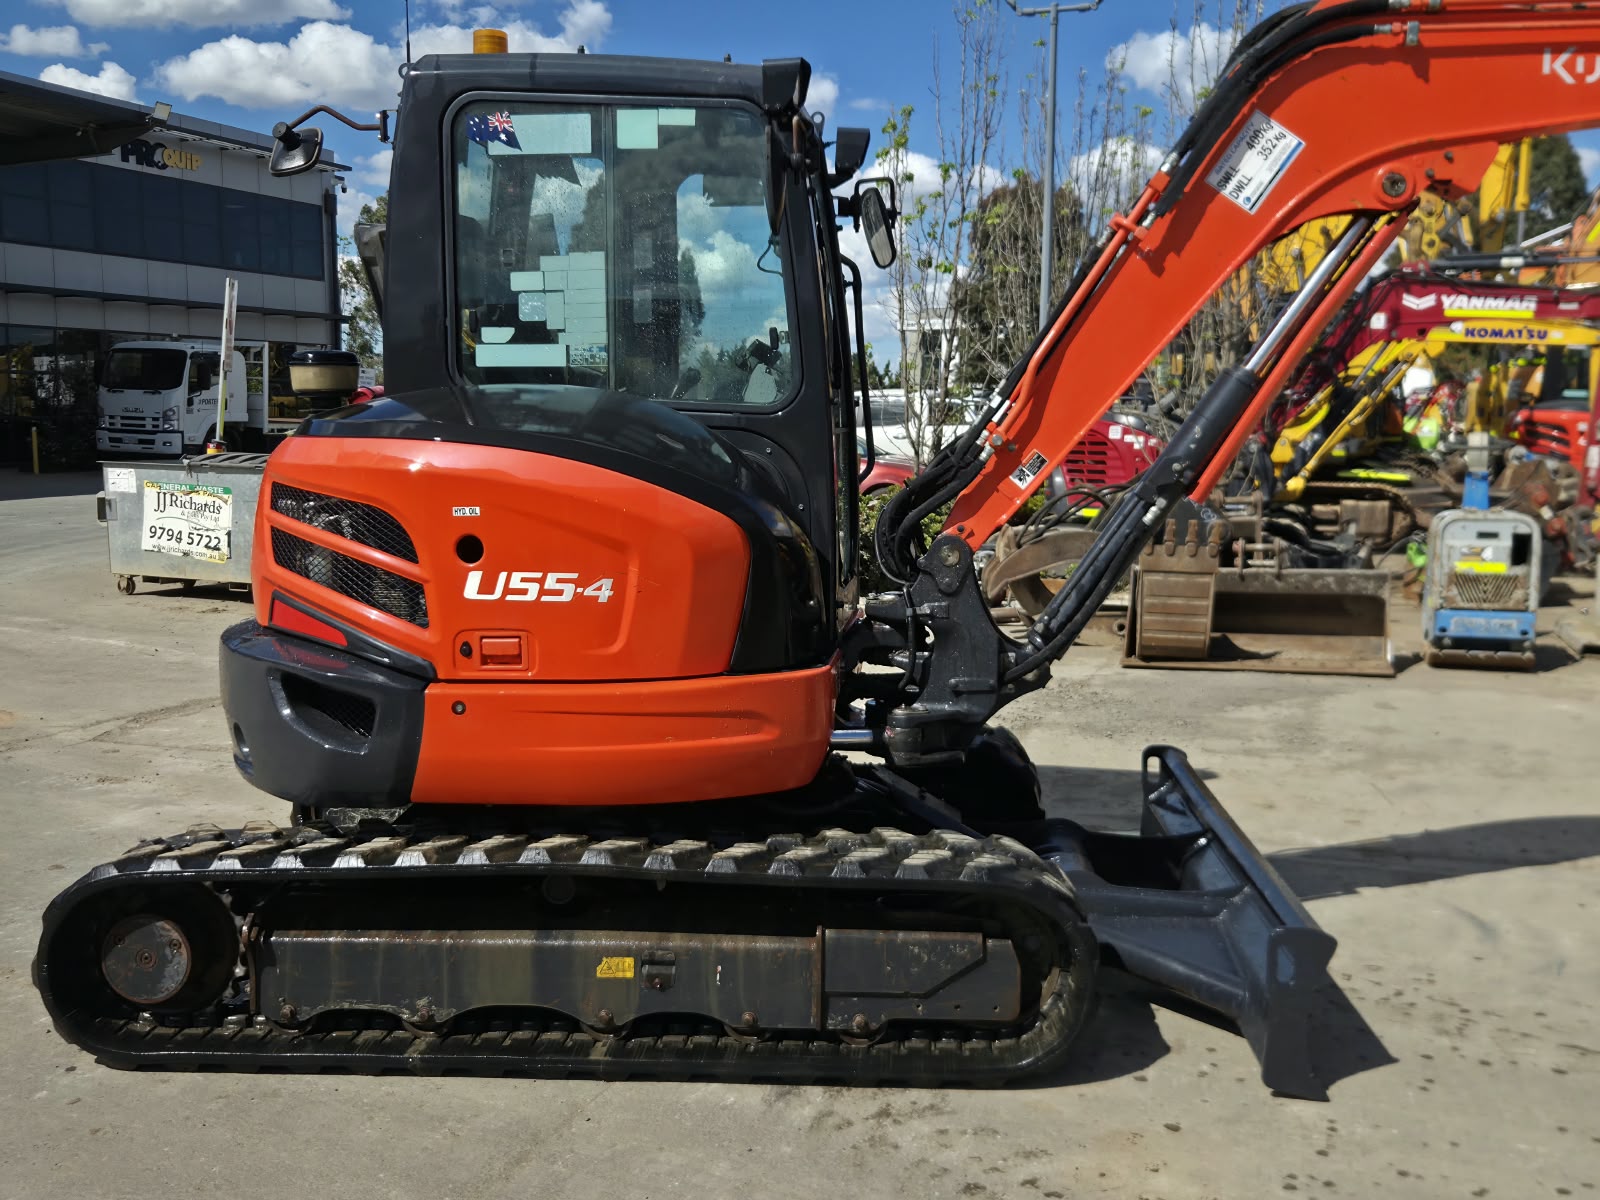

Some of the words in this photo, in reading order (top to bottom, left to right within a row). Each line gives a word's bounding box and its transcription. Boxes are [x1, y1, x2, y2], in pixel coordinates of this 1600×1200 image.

[1230, 122, 1254, 154] CAPACITY
[1216, 166, 1240, 190] SWLL
[1246, 129, 1265, 151] 400
[1228, 174, 1253, 200] DWLL
[1256, 138, 1277, 161] 352
[1440, 293, 1538, 311] YANMAR
[1465, 326, 1548, 339] KOMATSU
[153, 491, 168, 513] JJ
[169, 493, 223, 515] Richards
[454, 507, 468, 516] HYD.
[468, 507, 479, 516] OIL
[149, 525, 183, 544] 9794
[186, 532, 222, 551] 5722
[463, 570, 615, 603] U55-4
